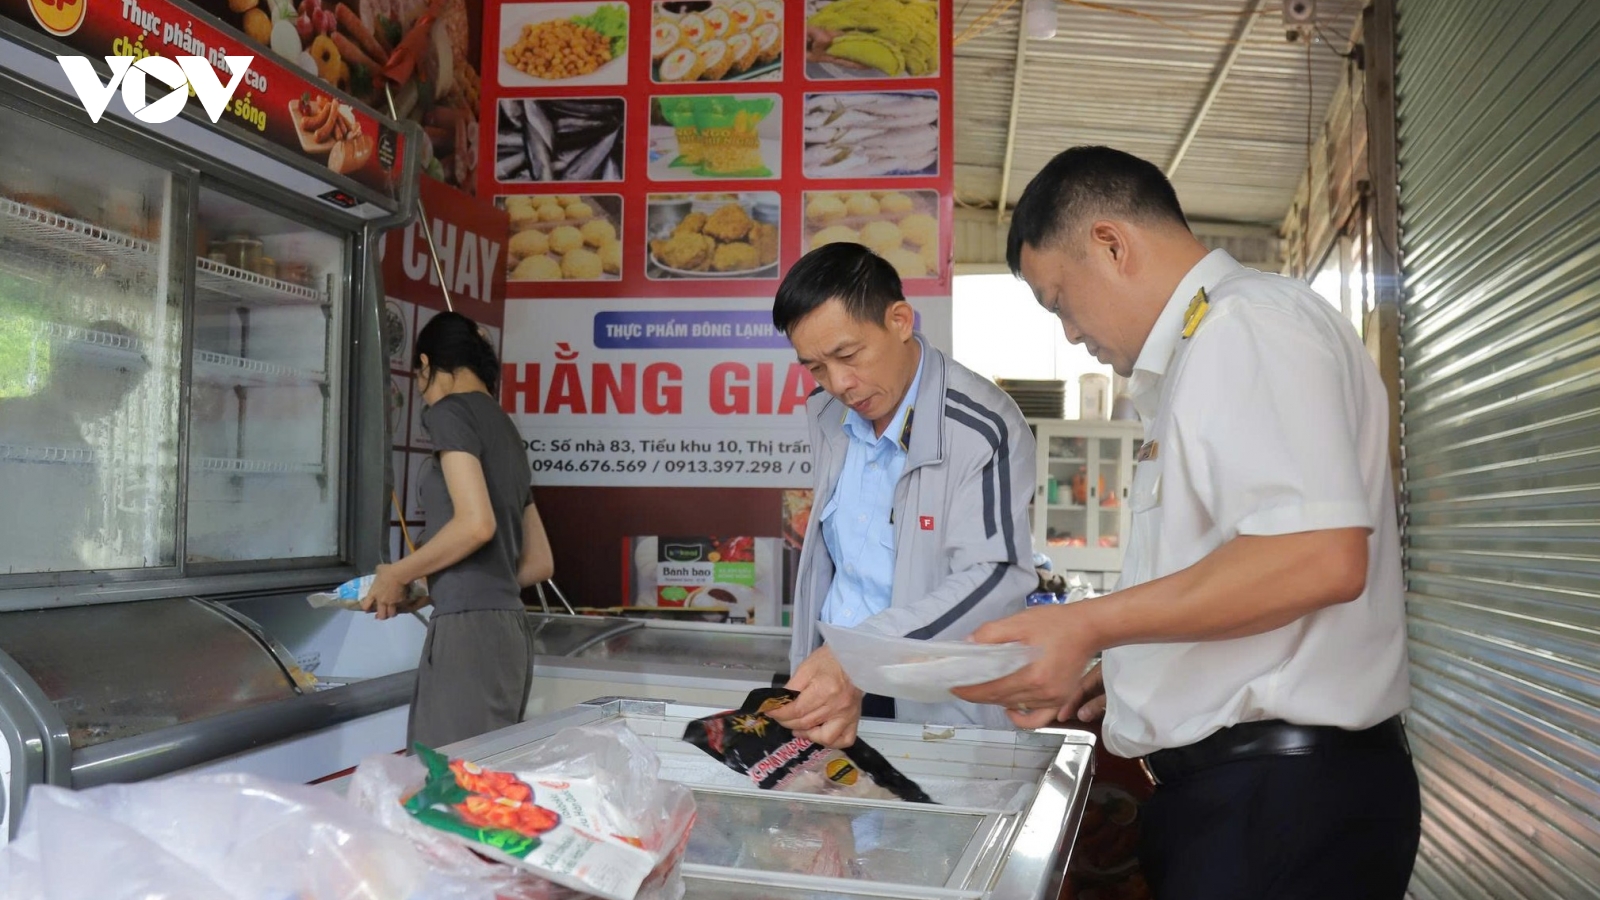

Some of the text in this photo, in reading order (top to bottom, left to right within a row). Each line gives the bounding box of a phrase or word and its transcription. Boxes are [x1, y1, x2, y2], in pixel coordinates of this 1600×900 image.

[121, 0, 161, 37] Thực
[163, 21, 206, 57] phẩm
[244, 68, 268, 93] cao
[234, 91, 267, 132] sống
[402, 212, 501, 304] CHAY
[606, 321, 643, 340] THỰC
[692, 320, 732, 338] ĐÔNG
[735, 323, 773, 340] LẠNH
[502, 342, 683, 415] HẰNG
[550, 438, 571, 452] Số
[575, 439, 605, 453] nhà
[610, 440, 636, 454] 83,
[639, 438, 676, 453] Tiểu
[680, 439, 712, 453] khu
[717, 440, 742, 455] 10,
[746, 440, 773, 456] Thị
[532, 459, 647, 473] 0946.676.569
[652, 460, 660, 474] /
[665, 460, 782, 474] 0913.397.298
[788, 461, 796, 475] /
[924, 519, 931, 527] F
[662, 566, 689, 577] Bánh
[692, 566, 711, 577] bao
